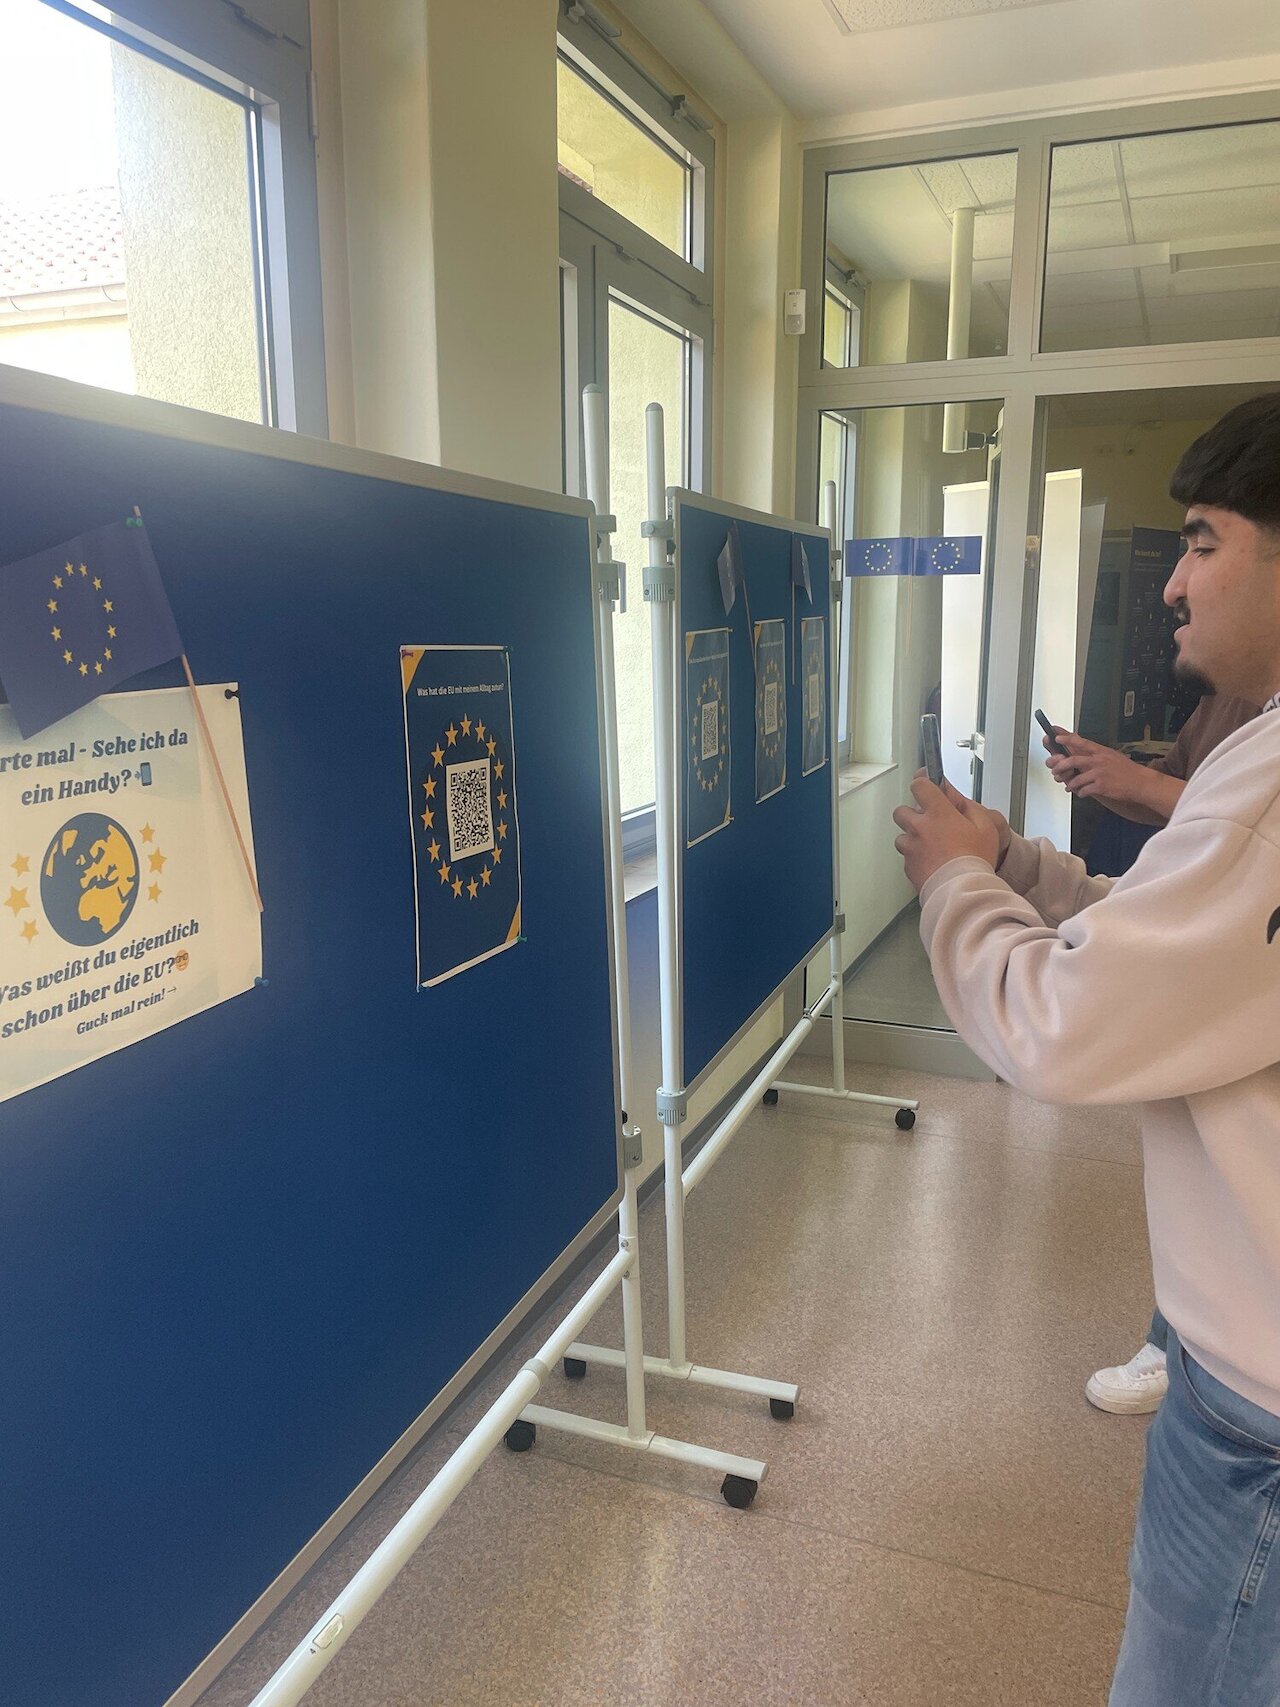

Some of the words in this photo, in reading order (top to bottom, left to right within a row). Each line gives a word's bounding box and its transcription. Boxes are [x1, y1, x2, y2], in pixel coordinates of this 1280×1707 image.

[417, 687, 428, 696] Was
[429, 687, 438, 695] hat
[438, 686, 447, 695] die
[448, 685, 454, 694] EU
[0, 753, 33, 772] rte
[36, 742, 76, 767] mal
[91, 736, 137, 759] Sehe
[139, 730, 165, 751] ich
[168, 728, 188, 747] da
[21, 784, 54, 806] ein
[57, 769, 132, 800] Handy?
[36, 957, 90, 991] weißt
[93, 949, 117, 970] du
[120, 919, 200, 960] eigentlich
[1, 1002, 64, 1039] schon
[67, 984, 110, 1013] über
[113, 971, 140, 994] die
[143, 957, 175, 984] EU?
[76, 1012, 109, 1035] Guck
[111, 1000, 135, 1021] mal
[137, 988, 165, 1011] rein!
